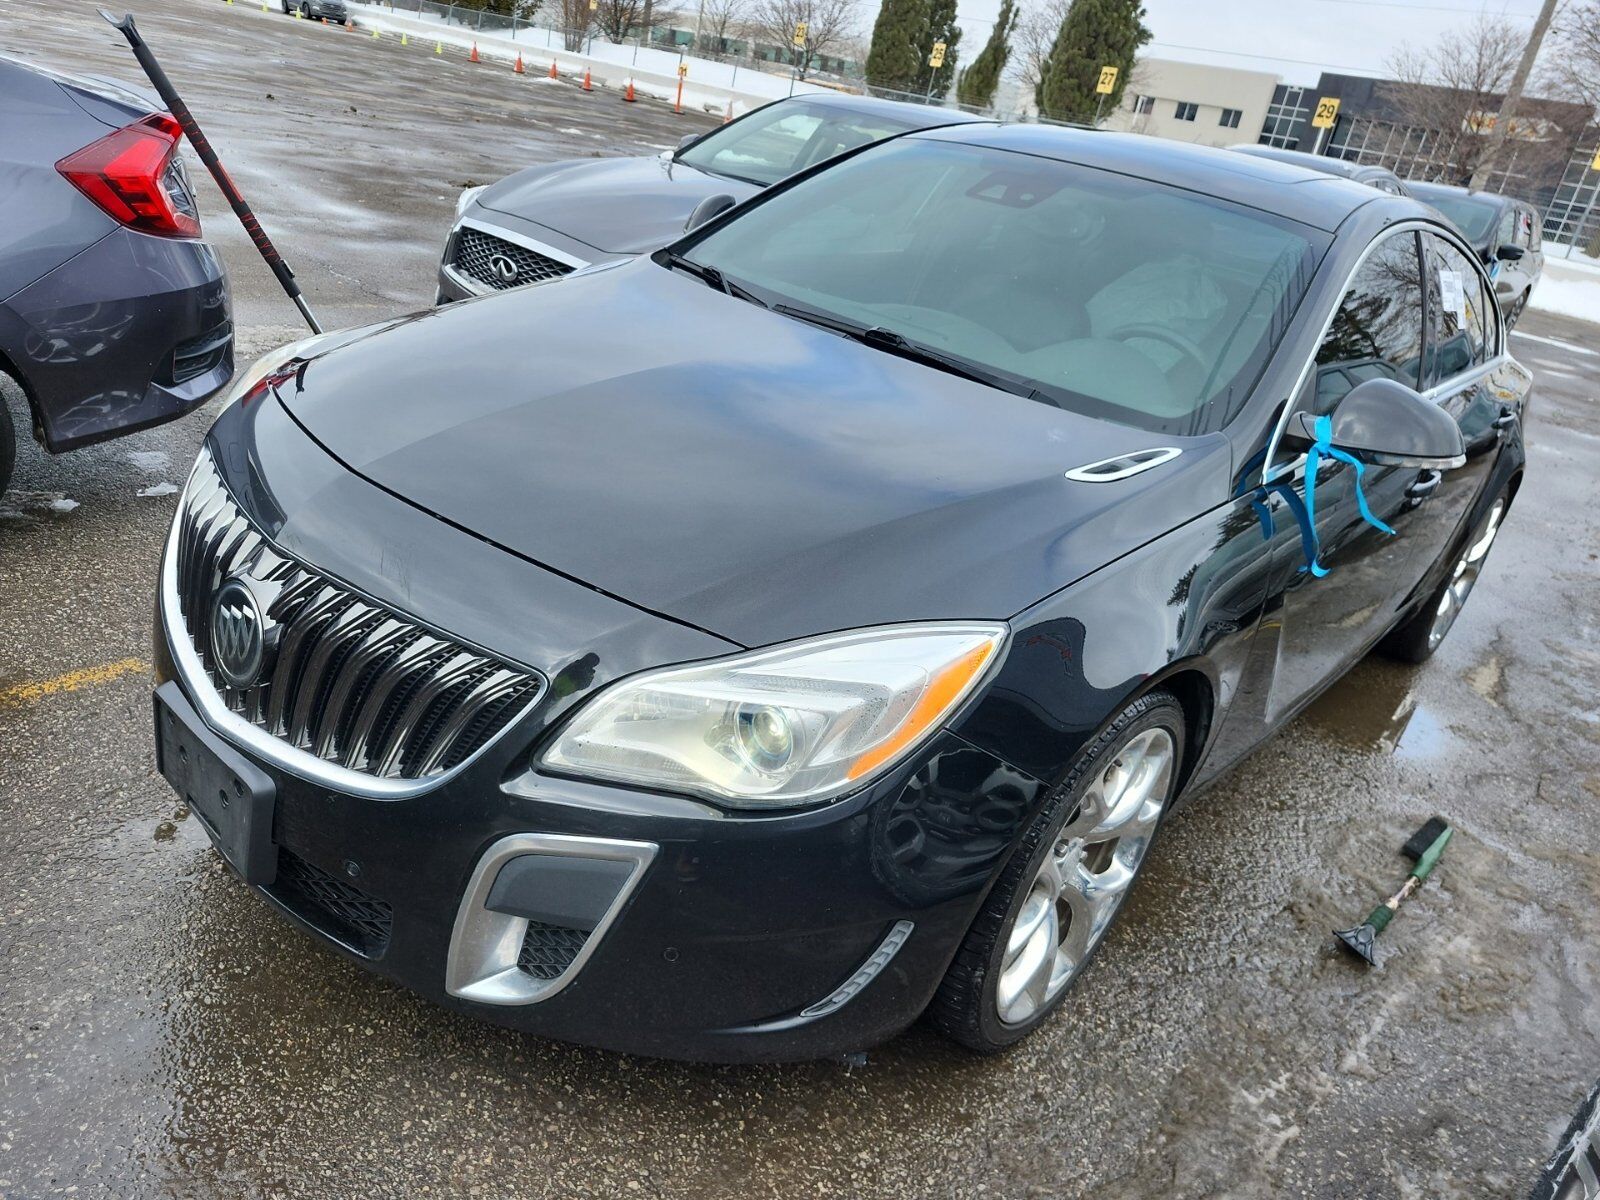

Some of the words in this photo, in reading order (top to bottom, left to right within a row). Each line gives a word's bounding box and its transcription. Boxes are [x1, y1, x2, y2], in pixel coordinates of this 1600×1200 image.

[933, 47, 943, 60] 25
[1100, 71, 1115, 85] 27
[1316, 103, 1335, 119] 29
